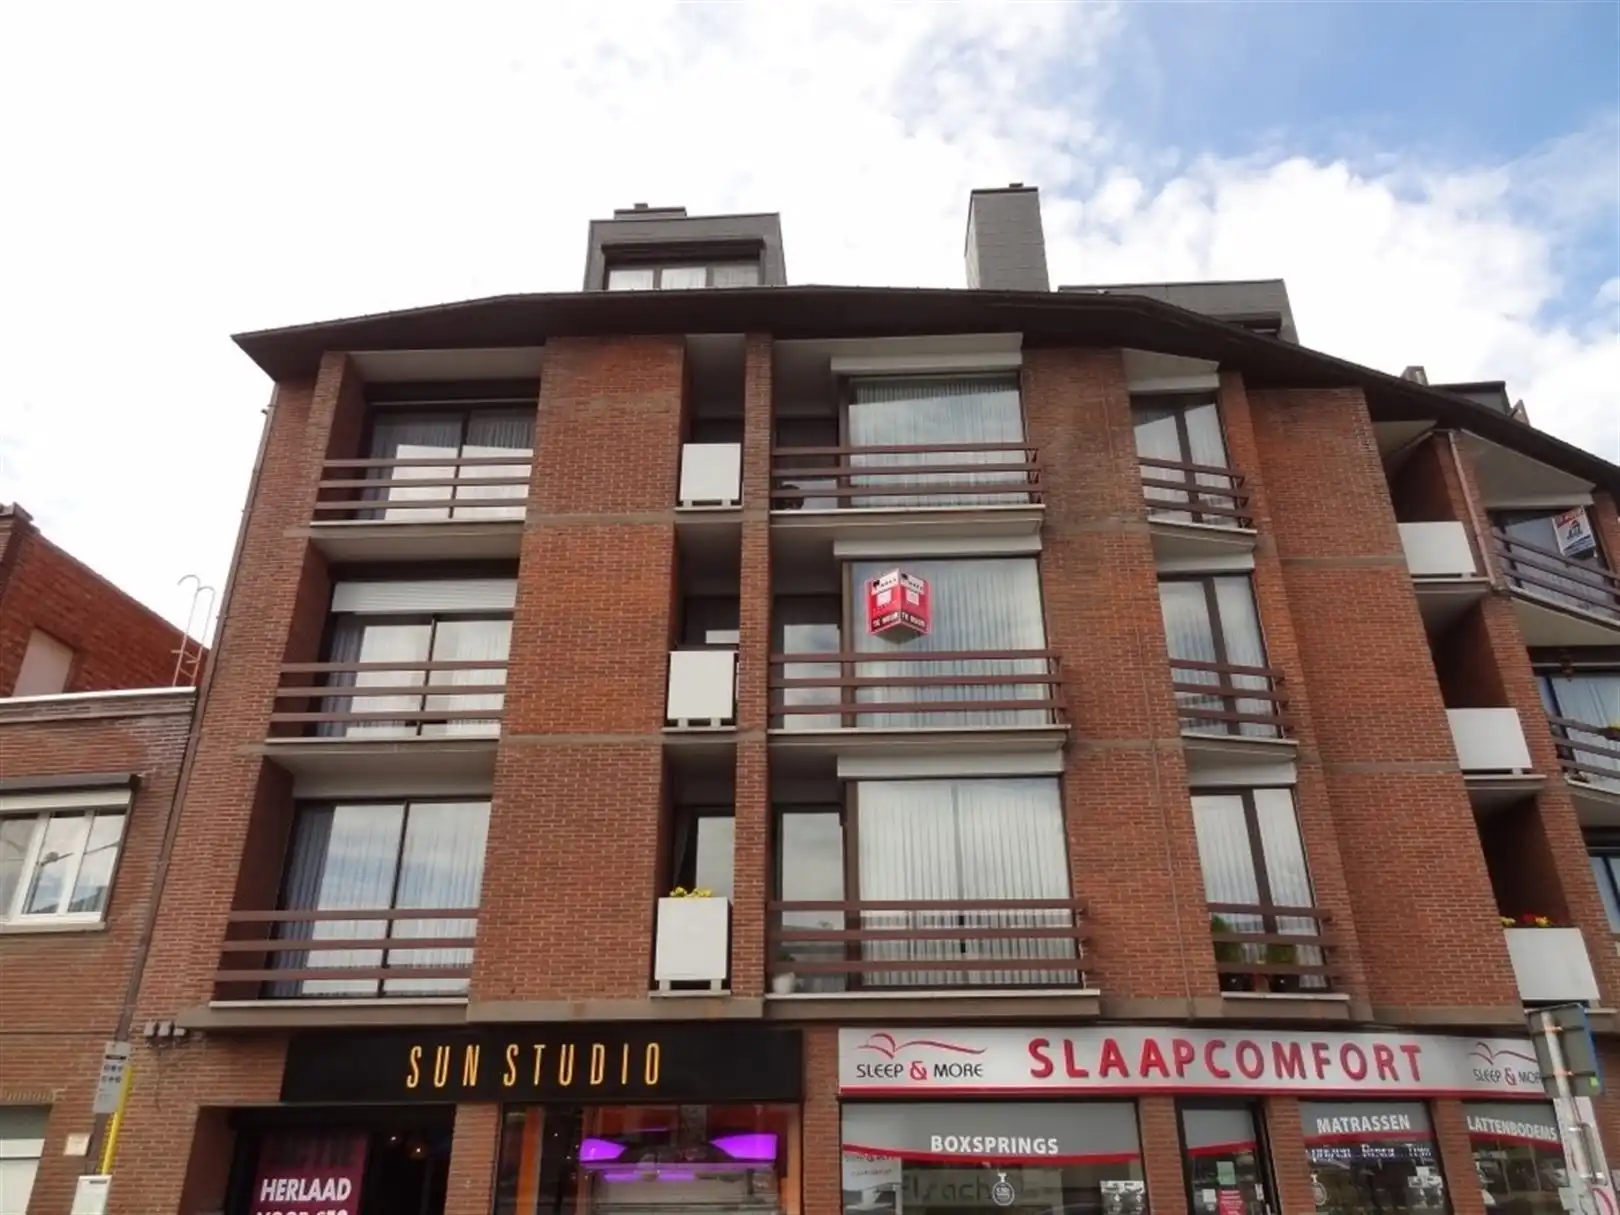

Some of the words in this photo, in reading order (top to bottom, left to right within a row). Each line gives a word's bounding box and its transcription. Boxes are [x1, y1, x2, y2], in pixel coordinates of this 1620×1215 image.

[405, 1044, 481, 1089] SUN
[502, 1042, 661, 1087] STUDIO
[856, 1063, 905, 1079] SLEEP
[909, 1061, 928, 1081] &
[933, 1063, 984, 1079] MORE
[1028, 1037, 1424, 1082] SLAAPCOMFORT
[1472, 1067, 1502, 1084] SLEEP
[1504, 1066, 1518, 1086] &
[1316, 1113, 1411, 1134] MATRASSEN
[1466, 1115, 1558, 1141] LATTENBODEMS
[930, 1134, 1060, 1155] BOXSPRINGS
[259, 1177, 353, 1202] HERLAAD
